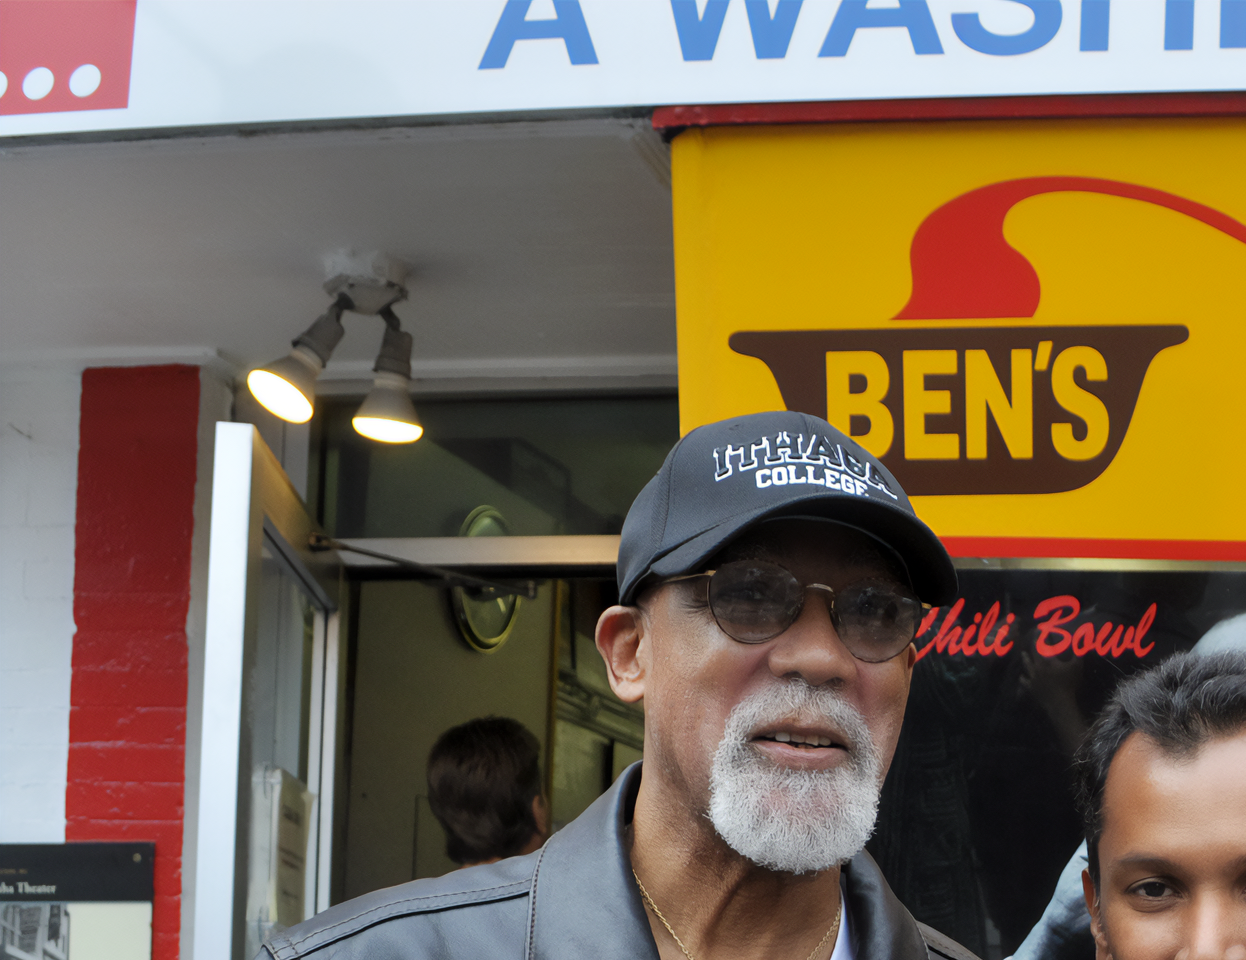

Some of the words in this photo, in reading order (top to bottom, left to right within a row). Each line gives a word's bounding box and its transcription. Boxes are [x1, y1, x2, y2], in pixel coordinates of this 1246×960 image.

[825, 341, 1110, 462] BEN'S
[713, 431, 898, 500] ITHACA
[755, 464, 870, 497] COLLEGE
[1033, 594, 1157, 658] Bowl
[16, 881, 57, 894] Theater
